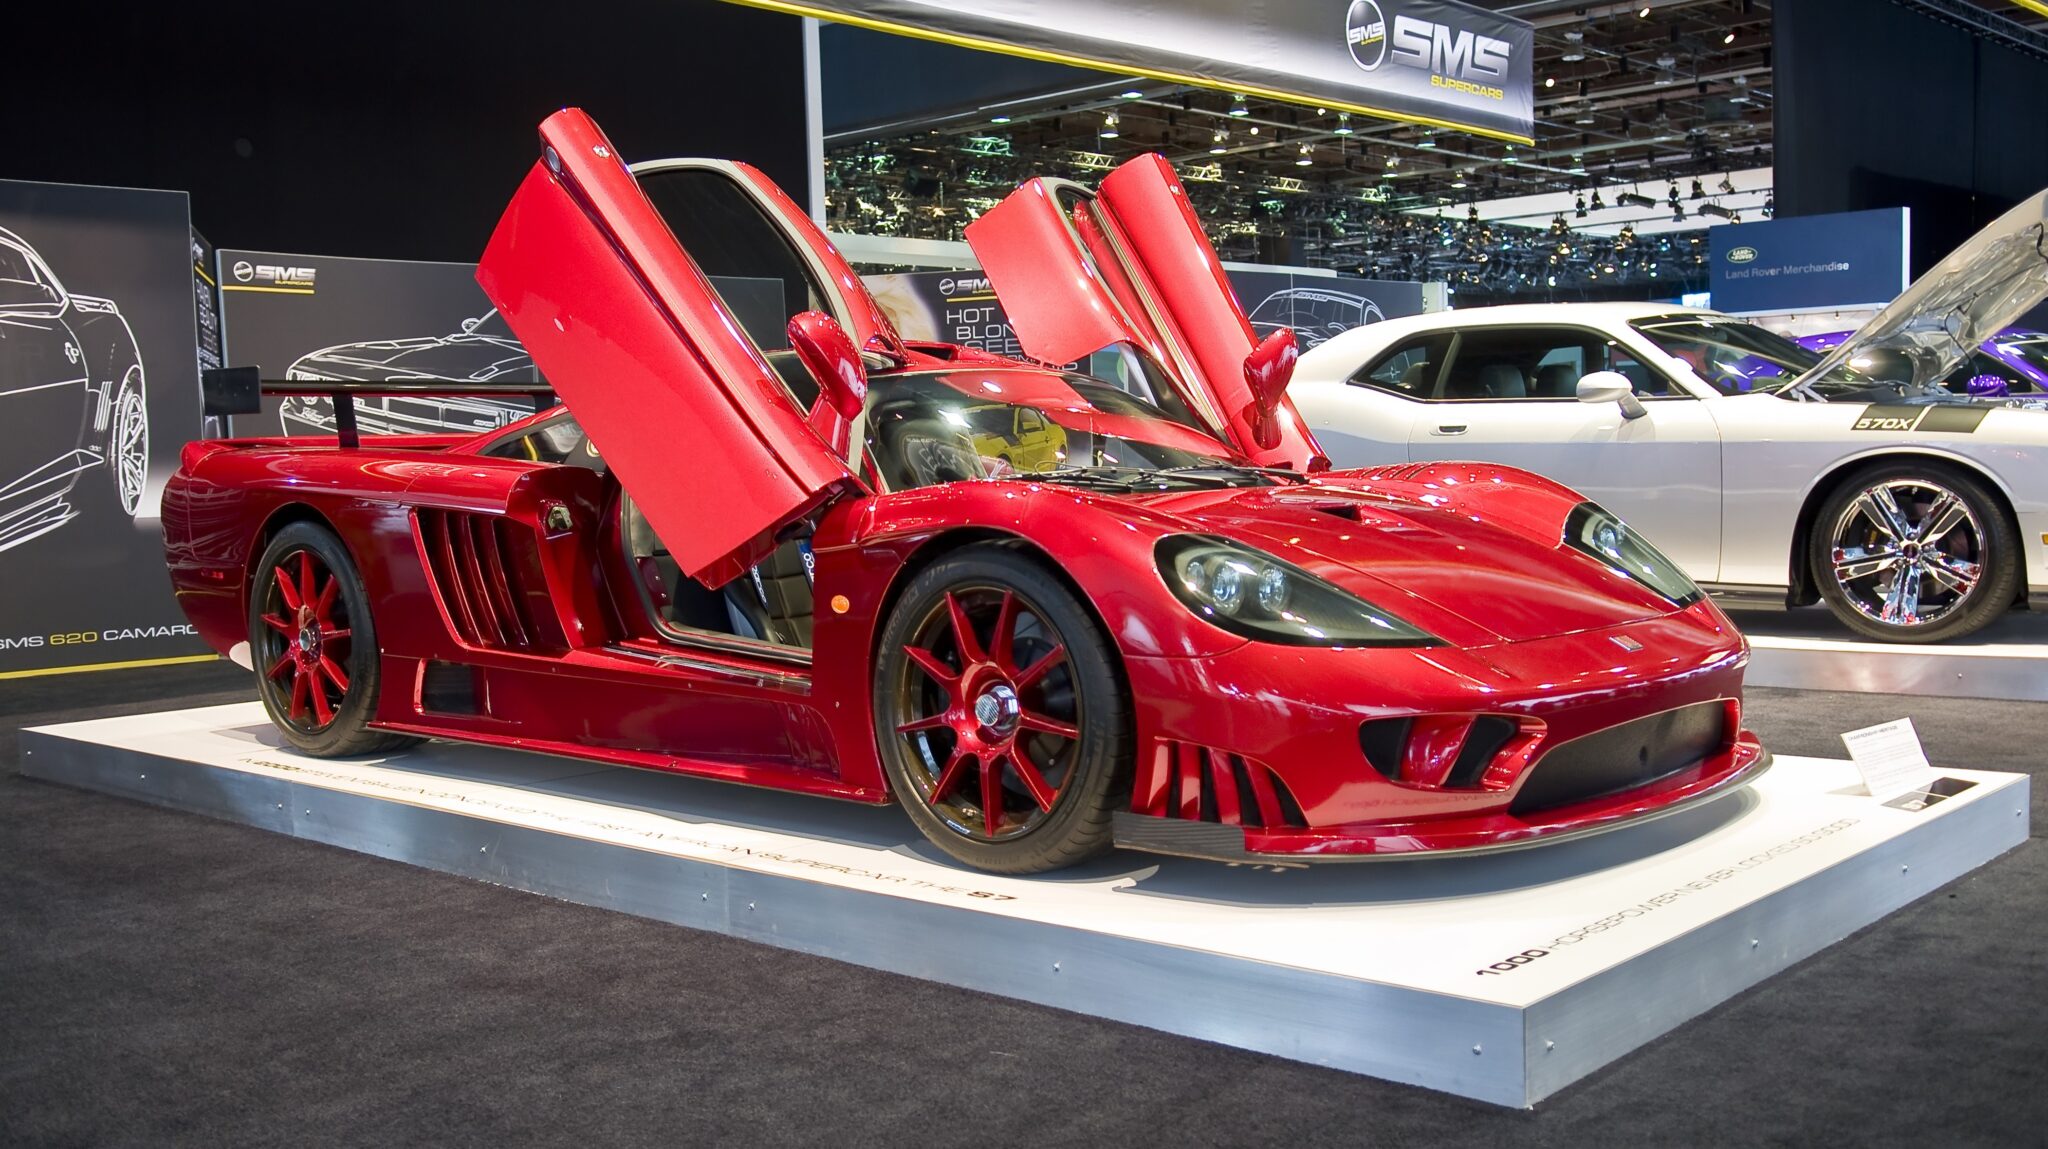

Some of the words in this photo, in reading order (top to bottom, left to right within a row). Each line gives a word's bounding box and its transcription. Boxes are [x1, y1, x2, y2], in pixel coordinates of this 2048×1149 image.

[1349, 21, 1384, 44] SMS
[1391, 14, 1510, 84] SMS
[1430, 74, 1504, 100] SUPERCARS
[255, 265, 316, 280] SMS
[1725, 269, 1750, 279] Land
[1752, 267, 1781, 277] Rover
[1783, 261, 1849, 275] Merchandise
[956, 278, 992, 291] SM
[946, 307, 995, 324] HOT
[956, 324, 1016, 340] BLON
[964, 337, 1021, 354] SEE
[1855, 418, 1914, 430] 570X
[50, 631, 98, 645] 620
[967, 891, 1018, 901] S7
[1476, 949, 1550, 976] 1000
[1539, 892, 1679, 950] HORSEPOWER
[1674, 868, 1734, 896] NEVER
